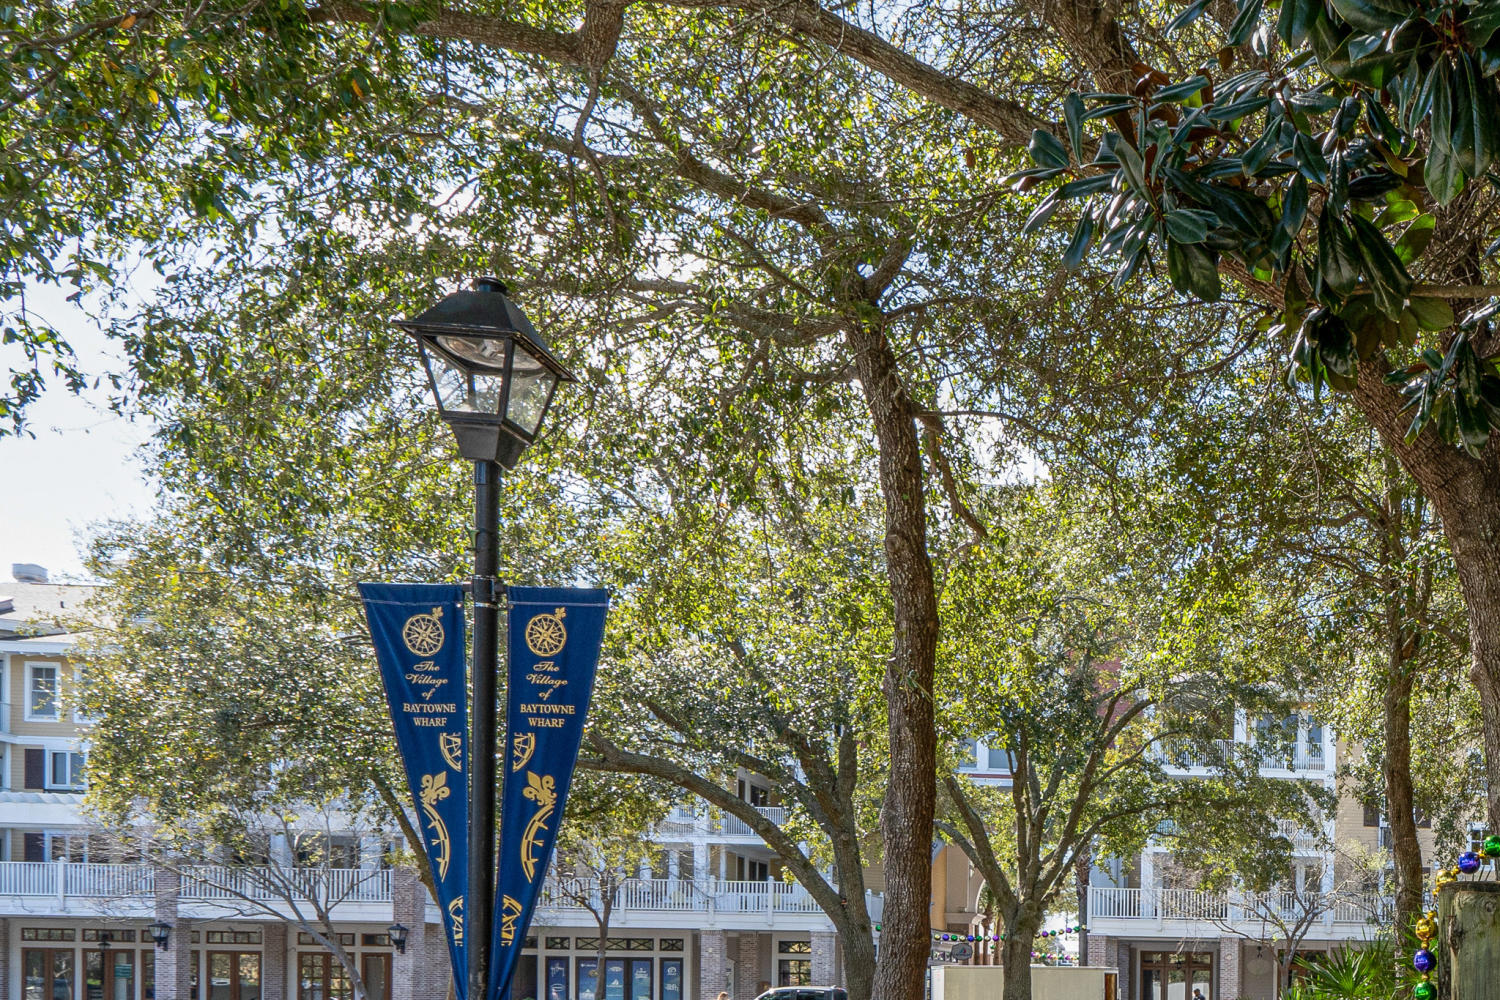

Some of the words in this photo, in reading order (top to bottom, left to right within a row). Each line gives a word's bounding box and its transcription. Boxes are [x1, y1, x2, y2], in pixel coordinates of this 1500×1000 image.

[413, 660, 440, 672] The
[532, 661, 560, 672] The
[405, 673, 449, 688] Village
[526, 673, 568, 689] Village
[421, 688, 436, 701] of
[538, 688, 553, 701] of
[403, 702, 457, 713] BAYTOWNE
[520, 703, 576, 715] BAYTOWNE
[413, 717, 447, 727] WHARF
[528, 717, 565, 728] WHARF
